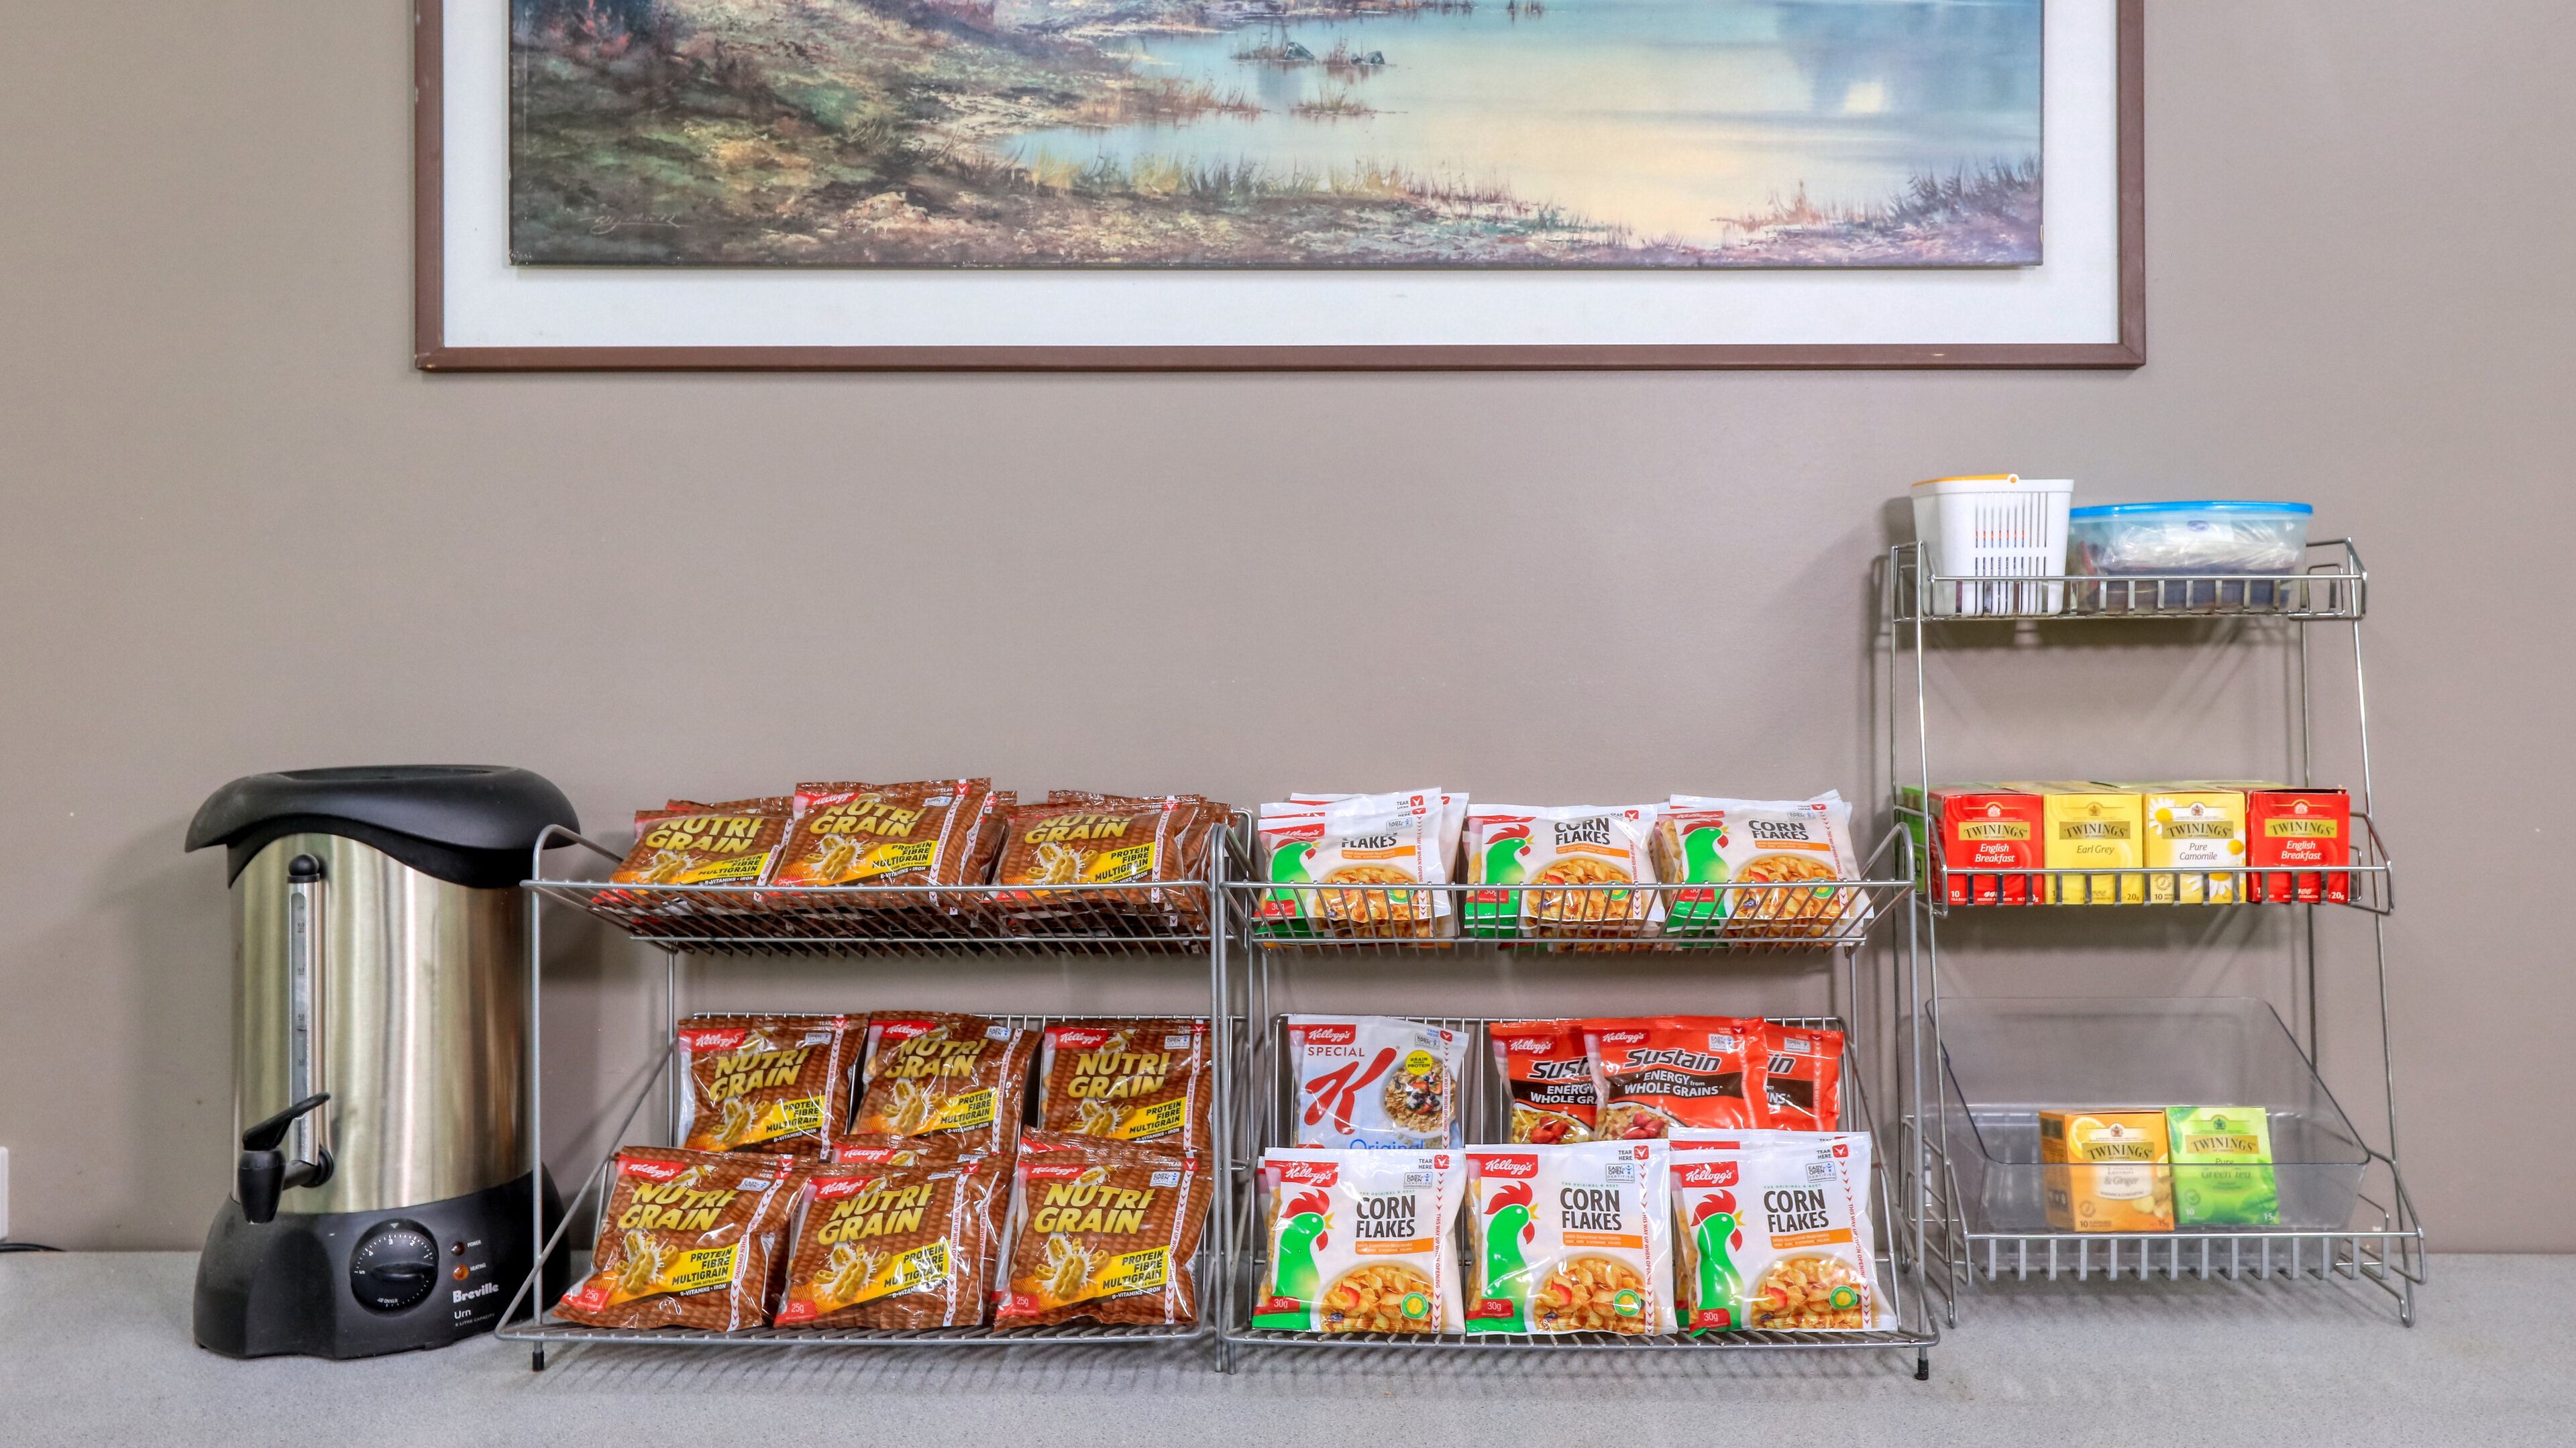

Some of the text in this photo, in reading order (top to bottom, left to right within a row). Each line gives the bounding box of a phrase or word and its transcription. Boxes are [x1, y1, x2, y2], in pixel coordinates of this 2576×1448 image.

[809, 816, 917, 838] GRAIN
[1554, 817, 1610, 832] CORN
[1748, 820, 1806, 832] CORN
[1964, 822, 2025, 839] TWININGS
[2064, 822, 2126, 838] TWININGS
[2166, 821, 2229, 838] TWININGS
[2270, 820, 2330, 836] TWININGS
[1024, 822, 1130, 844] GRAIN
[1556, 830, 1611, 846] FLAKES
[1752, 830, 1809, 840] FLAKES
[645, 830, 753, 853] GRAIN
[891, 842, 932, 851] PROTEIN
[1342, 835, 1397, 849] FLAKES
[1980, 843, 2009, 854] English
[2189, 842, 2208, 851] Pure
[2286, 840, 2316, 850] English
[902, 847, 930, 856] FIBRE
[1110, 845, 1150, 859] PROTEIN
[2077, 844, 2115, 855] Earl Grey
[2180, 852, 2218, 860] Camomile
[2281, 850, 2322, 860] Breakfast
[731, 859, 759, 867] FIBRE
[872, 854, 928, 869] MULTIGRAIN
[1122, 852, 1148, 863] FIBRE
[1974, 853, 2015, 864] Breakfast
[697, 866, 758, 876] MULTIGRAIN
[1950, 890, 1960, 898] 10
[2127, 893, 2140, 901] 20g
[2331, 892, 2345, 900] 20g
[885, 1025, 928, 1038] Kellogg's
[1060, 1032, 1102, 1045] Kellogg's
[1308, 1030, 1351, 1042] Kellogg's
[1603, 1032, 1646, 1043] Kellogg's
[696, 1034, 741, 1047] Kellogg's
[1510, 1040, 1553, 1055] Kellogg's
[1307, 1046, 1365, 1057] SPECIAL
[883, 1054, 979, 1078] GRAIN
[1623, 1048, 1722, 1072] Sustain
[1527, 1056, 1591, 1080] Sust
[708, 1064, 802, 1103] GRAIN
[1644, 1070, 1690, 1085] ENERGY
[1067, 1075, 1166, 1099] GRAIN
[1304, 1047, 1397, 1135] K
[1547, 1084, 1595, 1095] ENERGY
[1625, 1082, 1671, 1095] WHOLE
[959, 1091, 992, 1105] PROTEIN
[968, 1099, 991, 1111] FIBRE
[1530, 1092, 1574, 1104] WHOLE
[784, 1100, 820, 1111] PROTEIN
[794, 1107, 819, 1118] FIBRE
[1146, 1100, 1182, 1116] PROTEIN
[940, 1108, 990, 1124] MULTIGRAIN
[1156, 1107, 1181, 1121] FIBRE
[765, 1117, 818, 1133] MULTIGRAIN
[947, 1125, 975, 1133] B-VITAMINS
[1129, 1115, 1180, 1133] MULTIGRAIN
[773, 1131, 803, 1143] B-VITAMINS
[2191, 1137, 2255, 1152] TWININGS
[2088, 1144, 2151, 1160] TWININGS
[628, 1163, 677, 1178] Kellogg's
[1032, 1165, 1079, 1176] Kellogg's
[1286, 1166, 1333, 1182] Kellogg's
[1485, 1159, 1533, 1175] Kellogg's
[2201, 1168, 2251, 1179] Green Tea
[1685, 1168, 1733, 1184] Kellogg's
[2104, 1176, 2139, 1186] & Ginger
[820, 1179, 865, 1195] Kellogg's
[1356, 1194, 1415, 1220] CORN
[1560, 1187, 1621, 1213] CORN
[1764, 1188, 1826, 1213] CORN
[617, 1204, 723, 1231] GRAIN
[1034, 1207, 1145, 1234] GRAIN
[1562, 1211, 1622, 1231] FLAKES
[1767, 1211, 1829, 1233] FLAKES
[817, 1207, 926, 1245] GRAIN
[1356, 1219, 1415, 1238] FLAKES
[467, 1239, 482, 1247] POWER
[690, 1247, 733, 1263] PROTEIN
[1122, 1249, 1164, 1266] PROTEIN
[470, 1263, 486, 1272] HEATING
[702, 1256, 731, 1270] FIBRE
[735, 1254, 743, 1280] OPENING
[1134, 1259, 1163, 1273] FIBRE
[672, 1266, 729, 1286] MULTIGRAIN
[1102, 1269, 1162, 1290] MULTIGRAIN
[452, 1282, 499, 1303] Breville
[584, 1289, 599, 1302] 25g
[680, 1286, 710, 1296] B-VITAMINS
[1112, 1290, 1142, 1299] B-VITAMINS
[791, 1303, 804, 1313] 25g
[1016, 1296, 1029, 1307] 25g
[1274, 1298, 1289, 1309] 30g
[1487, 1301, 1501, 1313] 30g
[454, 1309, 471, 1319] Urn
[1704, 1311, 1718, 1322] 30g
